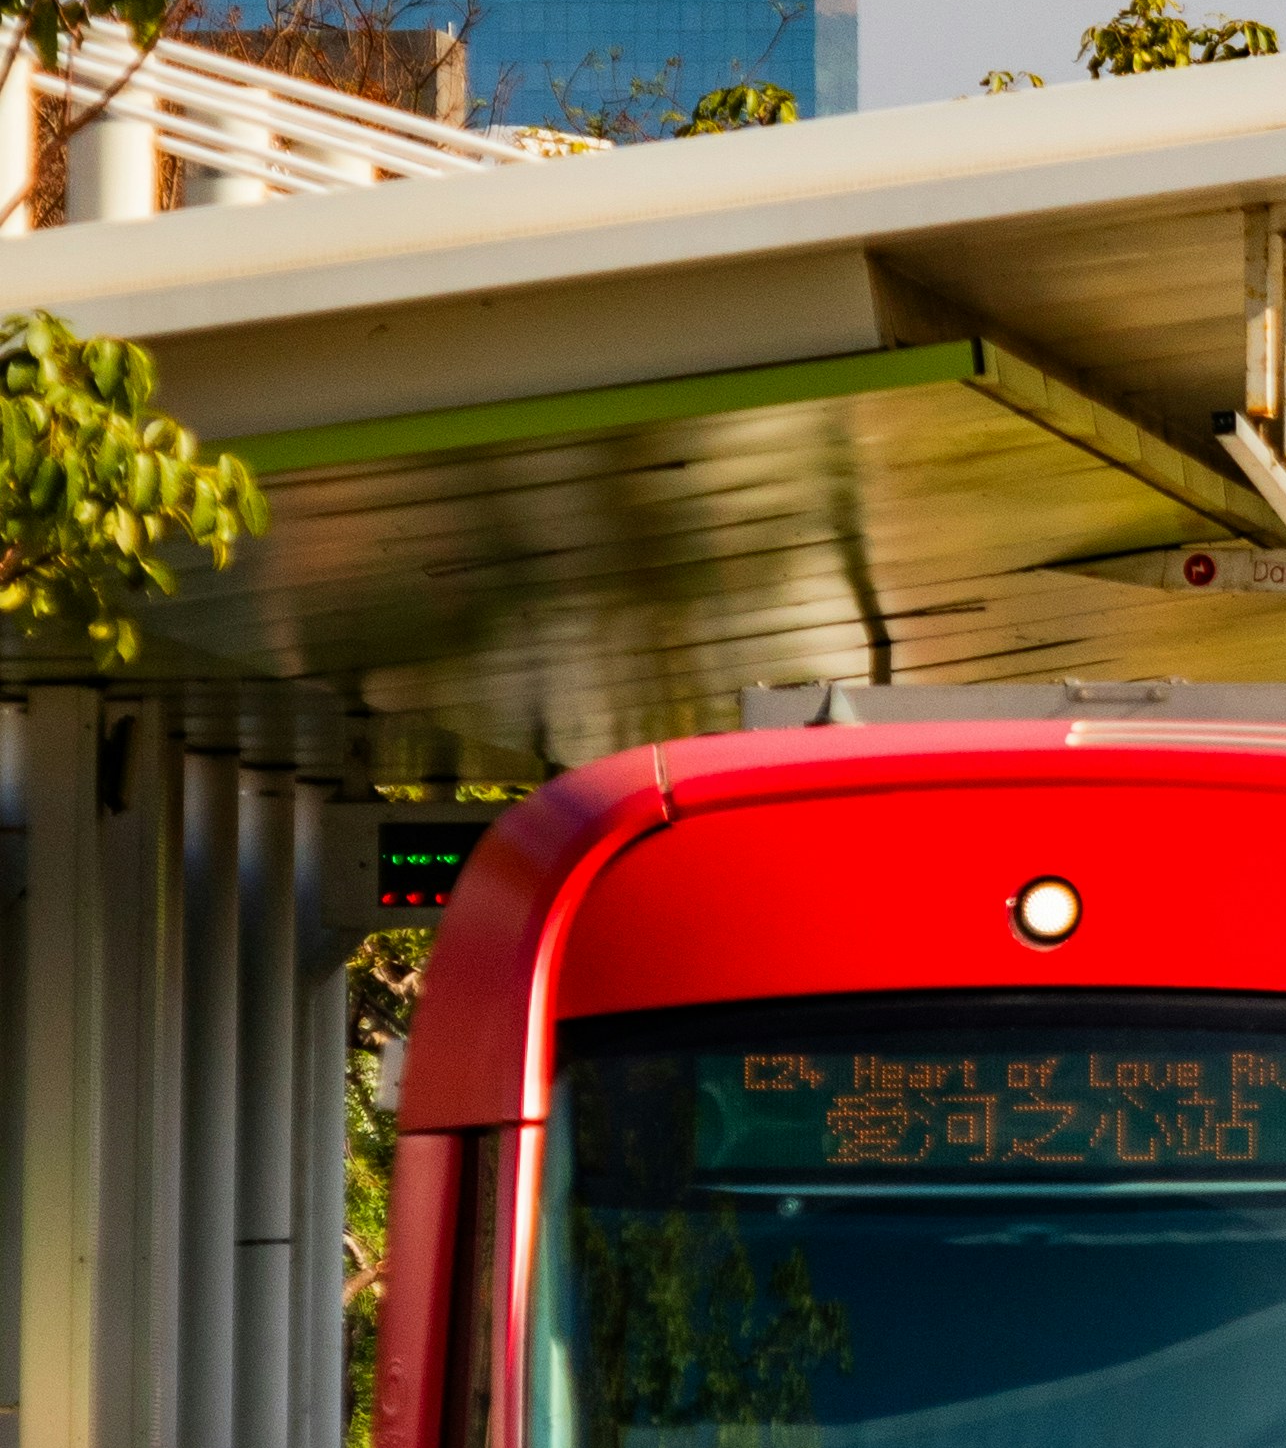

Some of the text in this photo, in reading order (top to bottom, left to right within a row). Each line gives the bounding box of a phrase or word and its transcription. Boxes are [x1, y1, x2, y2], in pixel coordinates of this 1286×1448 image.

[744, 1054, 823, 1089] C24
[854, 1054, 976, 1089] Heart
[1007, 1058, 1058, 1089] of
[1090, 1054, 1200, 1091] Love
[825, 1091, 1260, 1162] 愛河之心站
